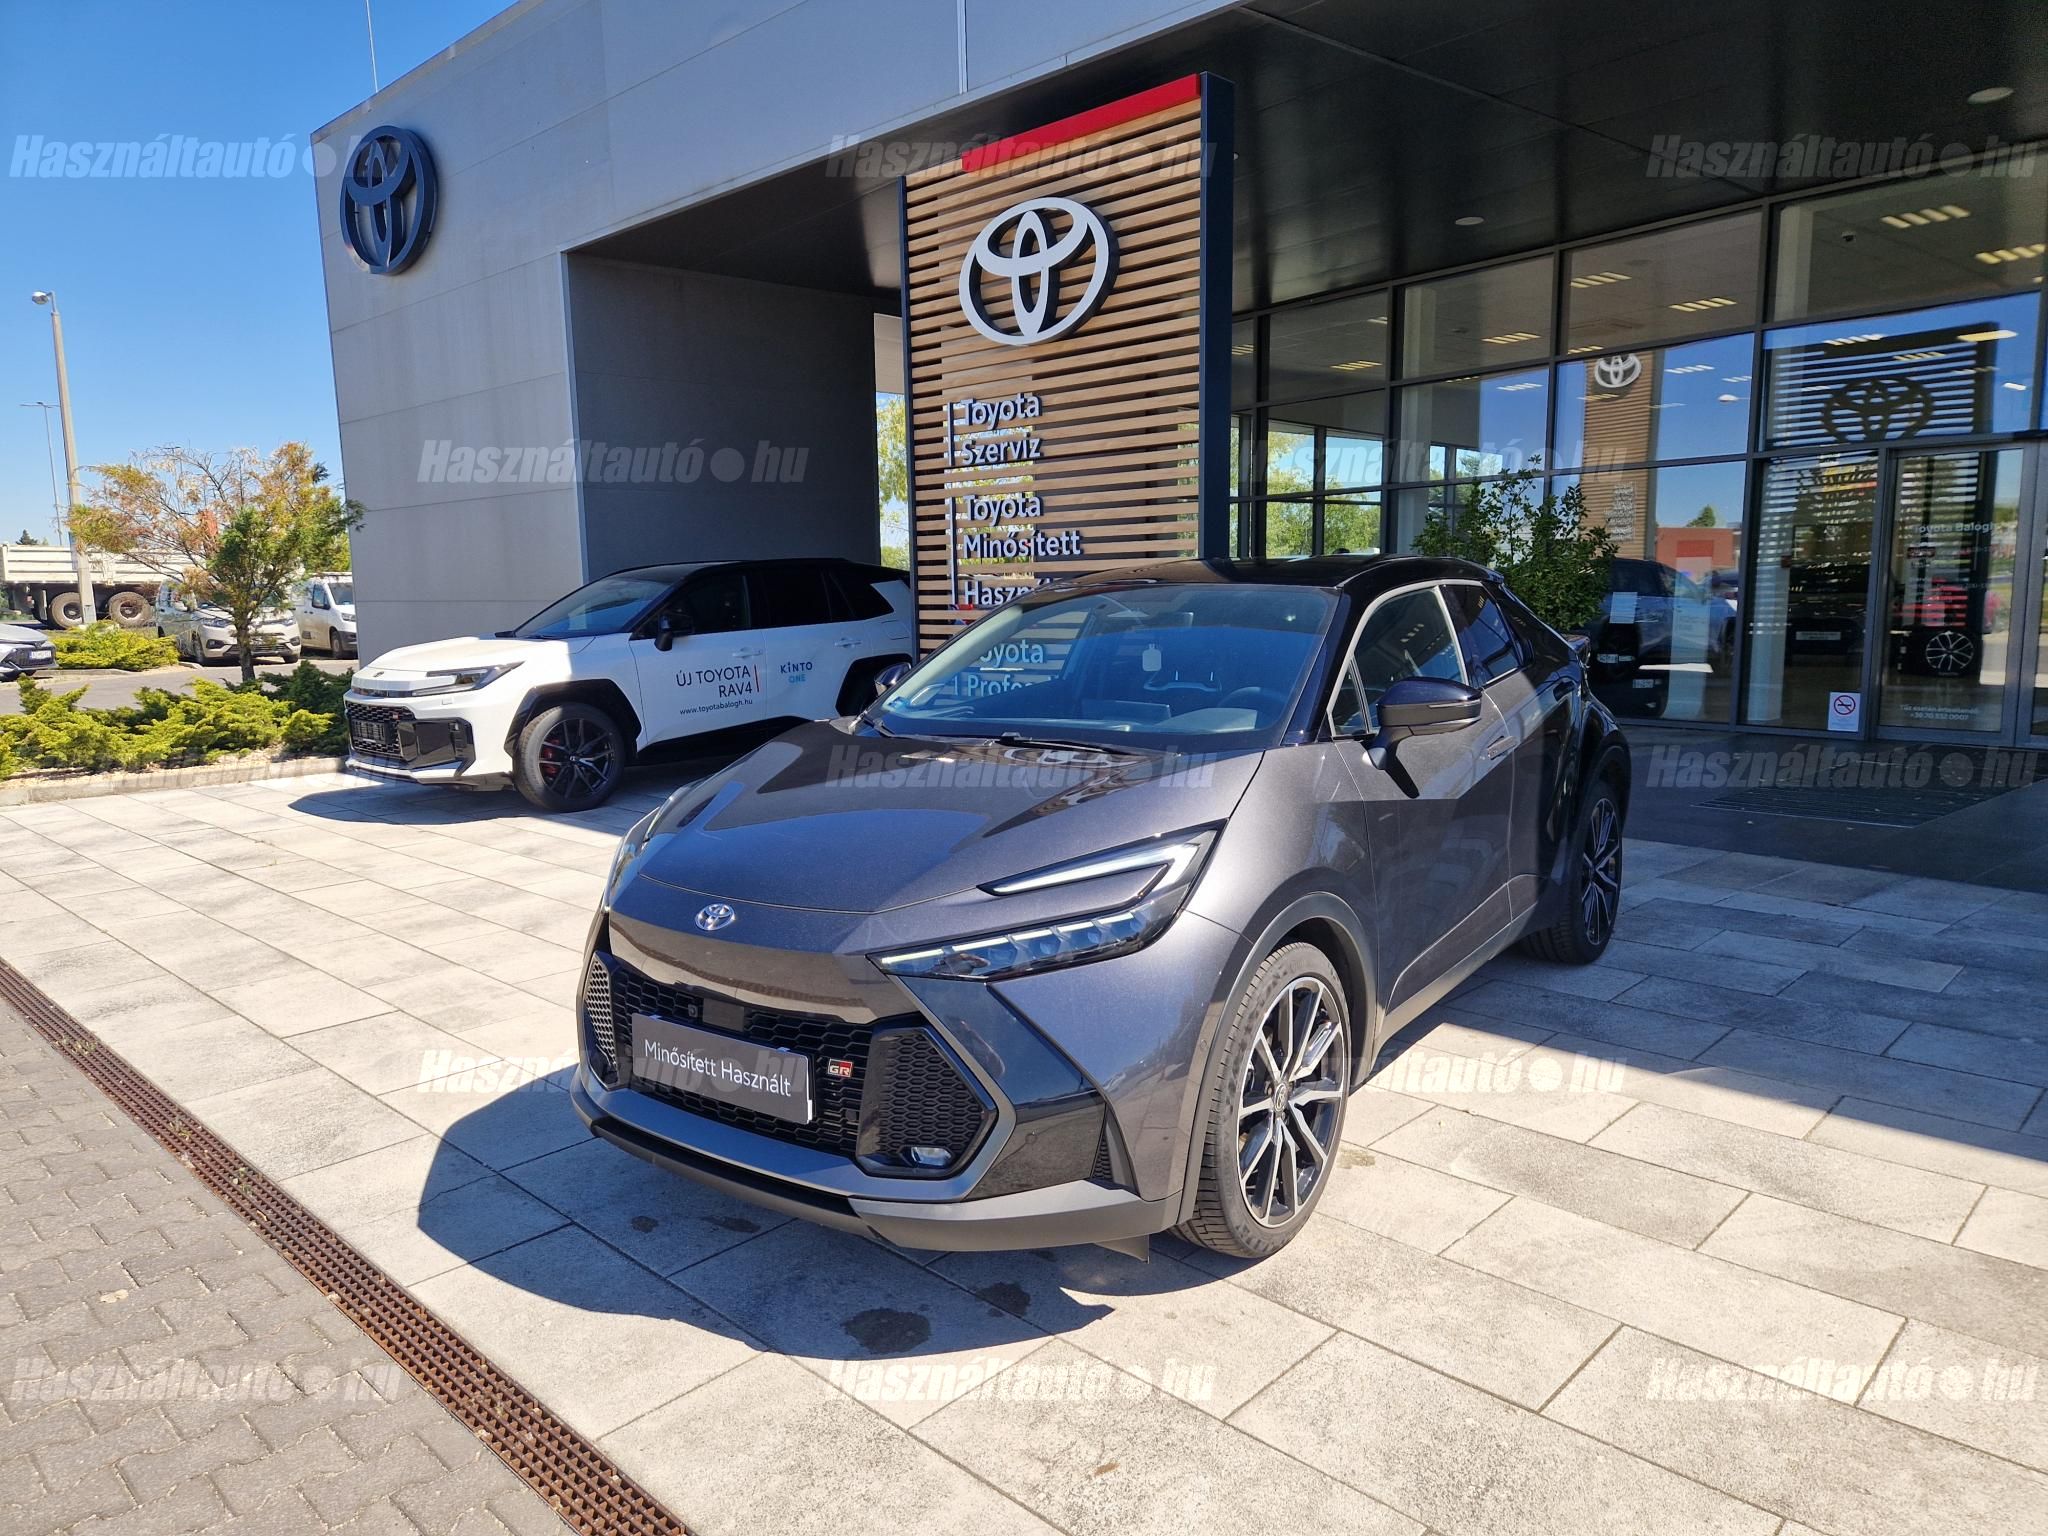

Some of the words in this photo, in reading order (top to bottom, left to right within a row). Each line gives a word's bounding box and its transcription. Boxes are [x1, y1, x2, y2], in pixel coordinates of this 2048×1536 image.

[961, 393, 1041, 429] Toyota
[963, 433, 1041, 465] Szerviz
[963, 494, 1042, 527] Toyota
[963, 531, 1082, 558] Minősített
[676, 670, 692, 687] ÚJ
[696, 665, 751, 684] TOYOTA
[788, 673, 807, 683] ONE
[718, 681, 753, 699] RAV4
[679, 699, 753, 716] www.toyotabalogh.hu
[644, 1039, 717, 1078] Minősített
[721, 1060, 792, 1097] Használt
[829, 1063, 851, 1076] GR
